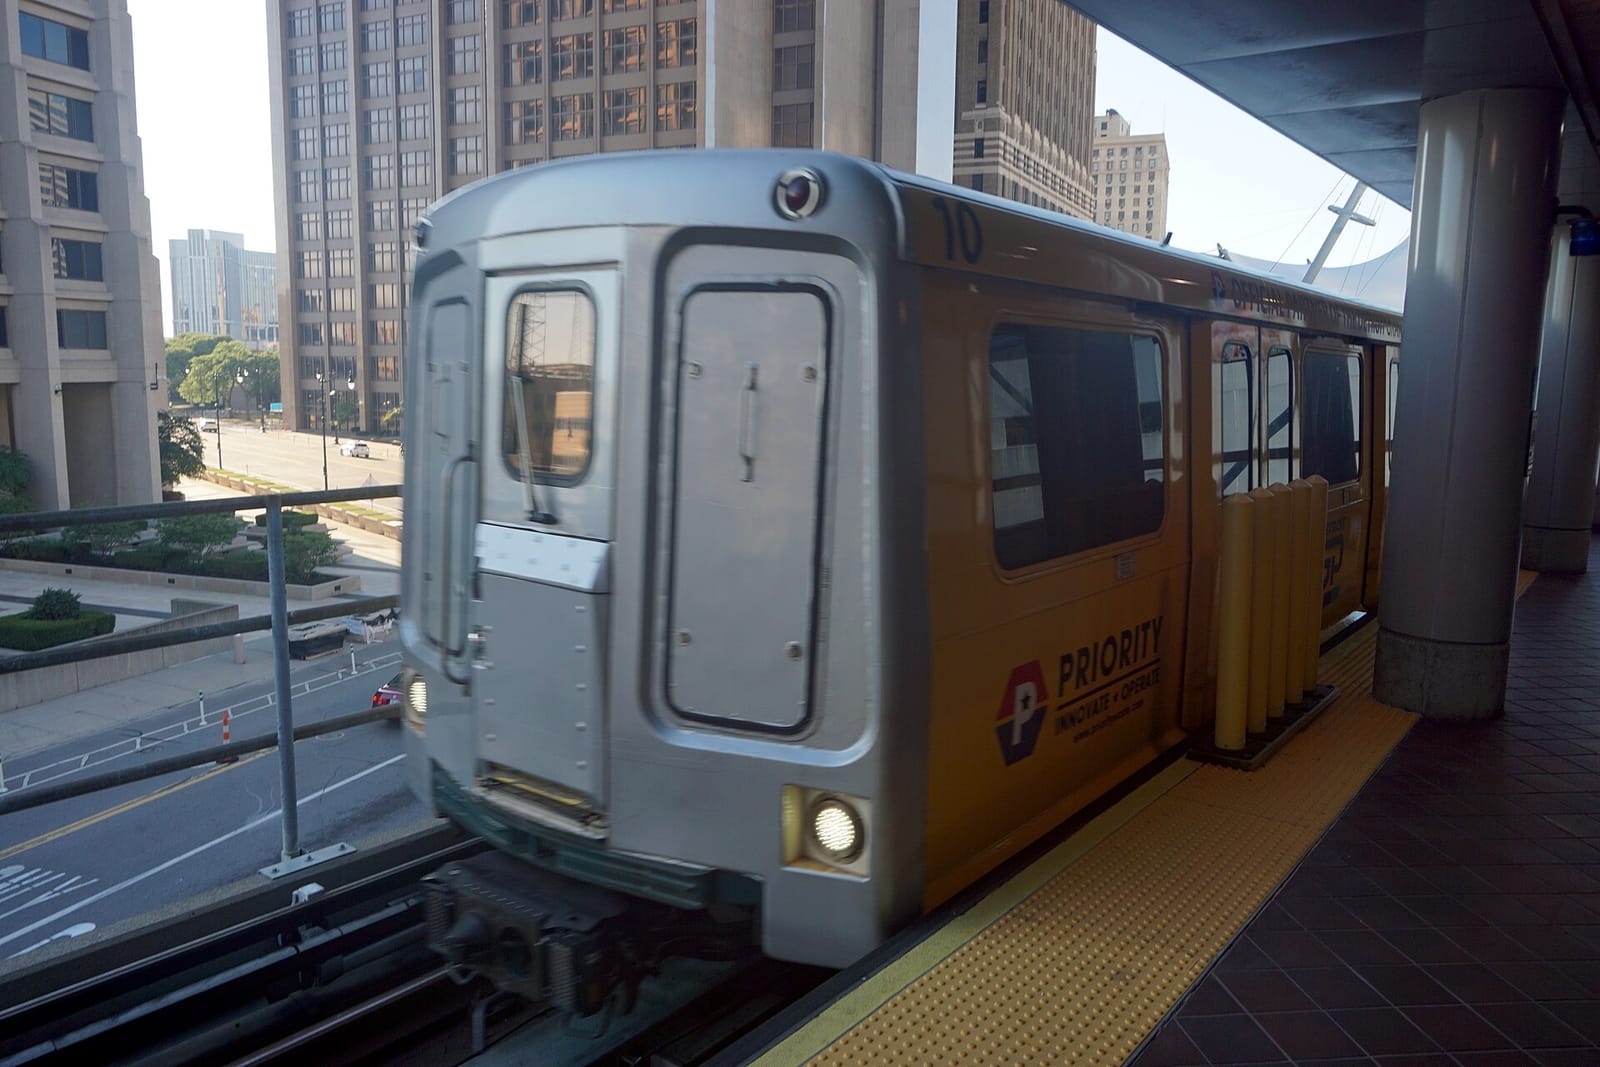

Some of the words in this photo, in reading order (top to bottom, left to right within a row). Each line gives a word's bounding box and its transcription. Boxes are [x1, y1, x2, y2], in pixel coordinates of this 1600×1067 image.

[933, 196, 982, 264] 10
[1232, 279, 1284, 317] OFFICIAL
[1057, 615, 1164, 698] PRIORITY
[1055, 692, 1110, 736] INNOVATE
[1121, 667, 1161, 701] OPERATE
